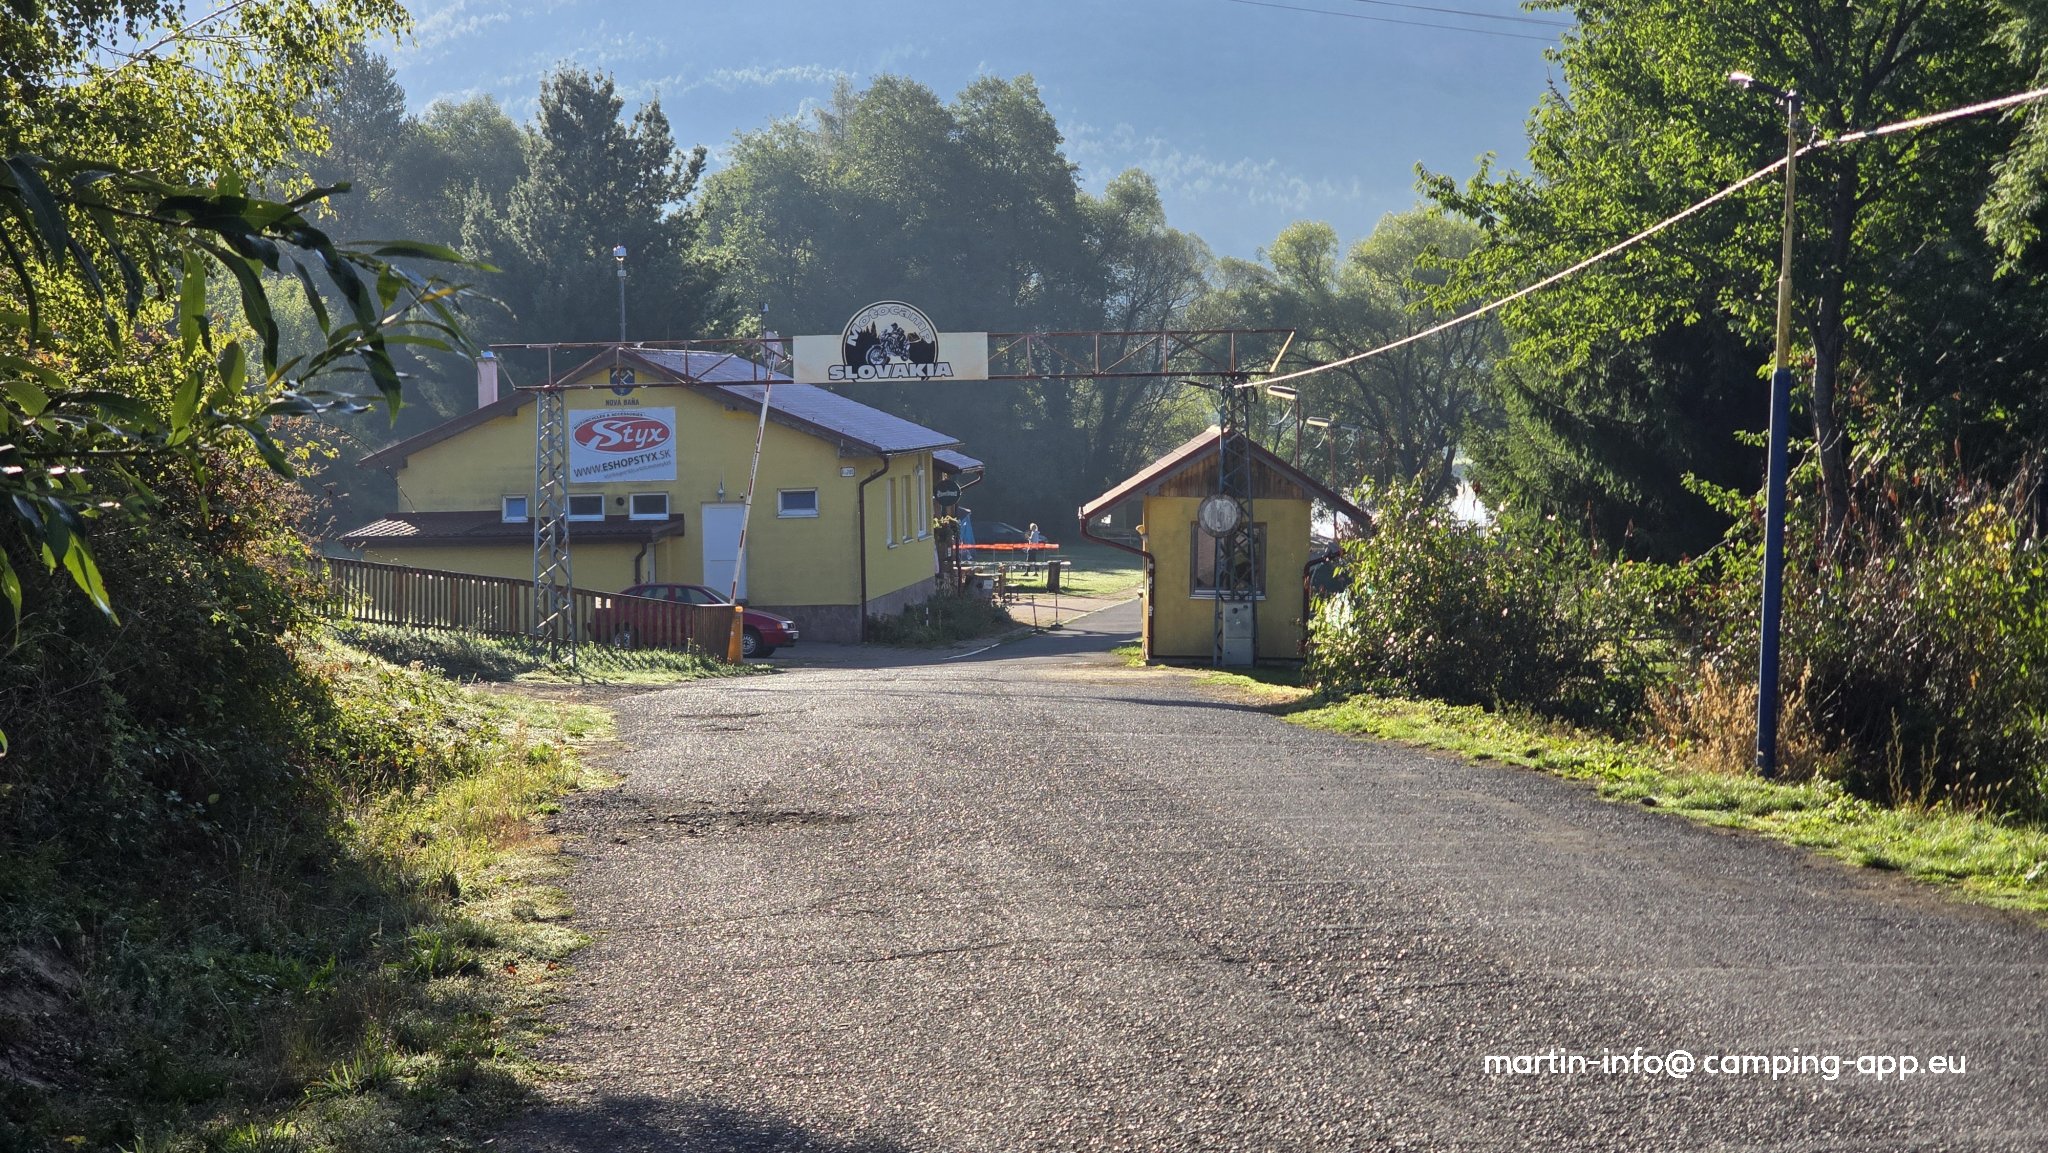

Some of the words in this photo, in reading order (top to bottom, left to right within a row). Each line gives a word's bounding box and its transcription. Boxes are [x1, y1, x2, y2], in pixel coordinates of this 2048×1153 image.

[847, 305, 934, 347] Motocamp
[828, 362, 954, 381] SLOVAKIA
[580, 420, 667, 450] Styx
[574, 449, 671, 477] WWW.ESHOPSTYX.SK
